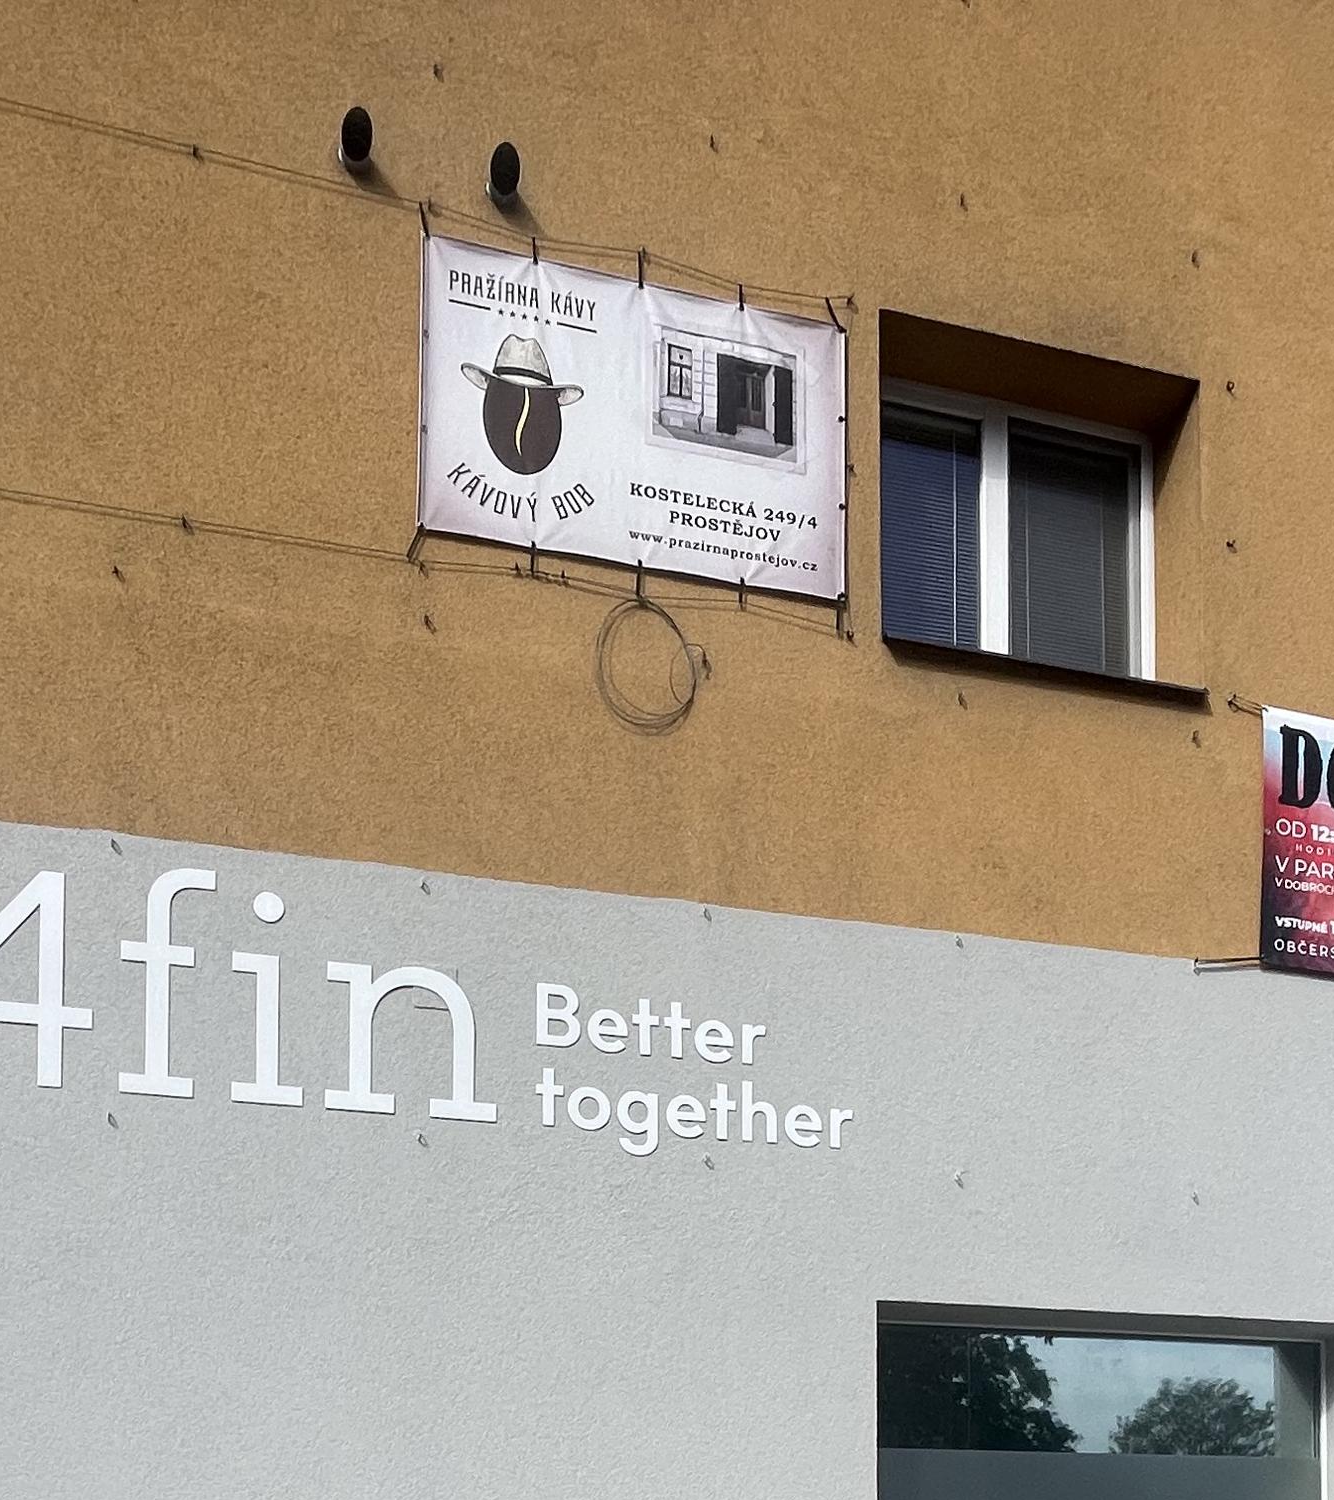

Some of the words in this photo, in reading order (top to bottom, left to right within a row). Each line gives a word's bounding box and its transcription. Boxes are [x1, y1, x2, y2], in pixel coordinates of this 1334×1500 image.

[449, 269, 540, 309] PRAŽÍRNA
[551, 289, 597, 322] KÁVY
[446, 462, 538, 522] KÁVOVÝ
[551, 483, 596, 521] BOB
[630, 482, 757, 518] KOSTELECKÁ
[763, 508, 818, 530] 249/4
[669, 510, 781, 542] PROSTĚJOV
[628, 530, 818, 572] www.prazirnaprostejov.cz
[1275, 818, 1306, 838] OD
[1275, 855, 1289, 873] V
[1275, 877, 1284, 887] V
[535, 982, 767, 1066] Better
[535, 1067, 855, 1157] together
